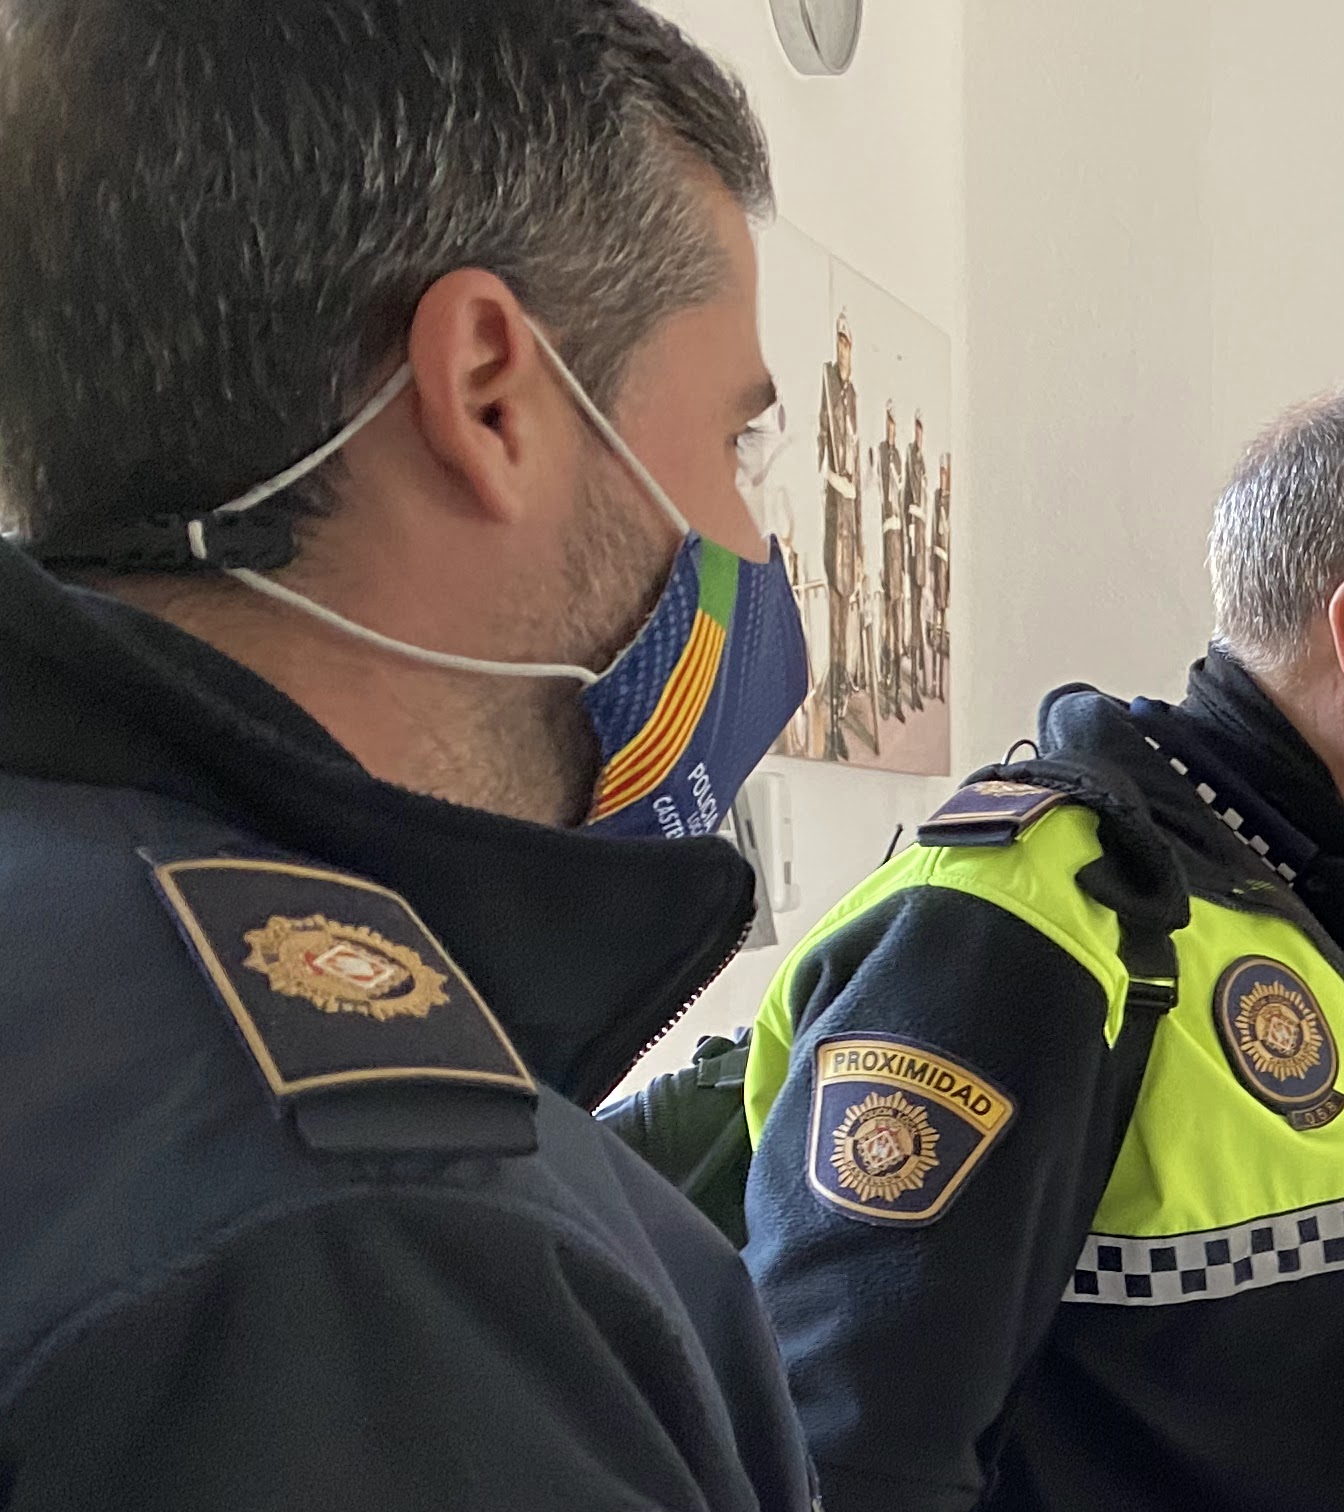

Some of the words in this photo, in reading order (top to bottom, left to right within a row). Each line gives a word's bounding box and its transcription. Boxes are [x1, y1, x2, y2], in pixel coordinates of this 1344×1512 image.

[652, 795, 685, 839] CASTE
[687, 762, 719, 834] POLICIA
[833, 1051, 992, 1116] PROXIMIDAD
